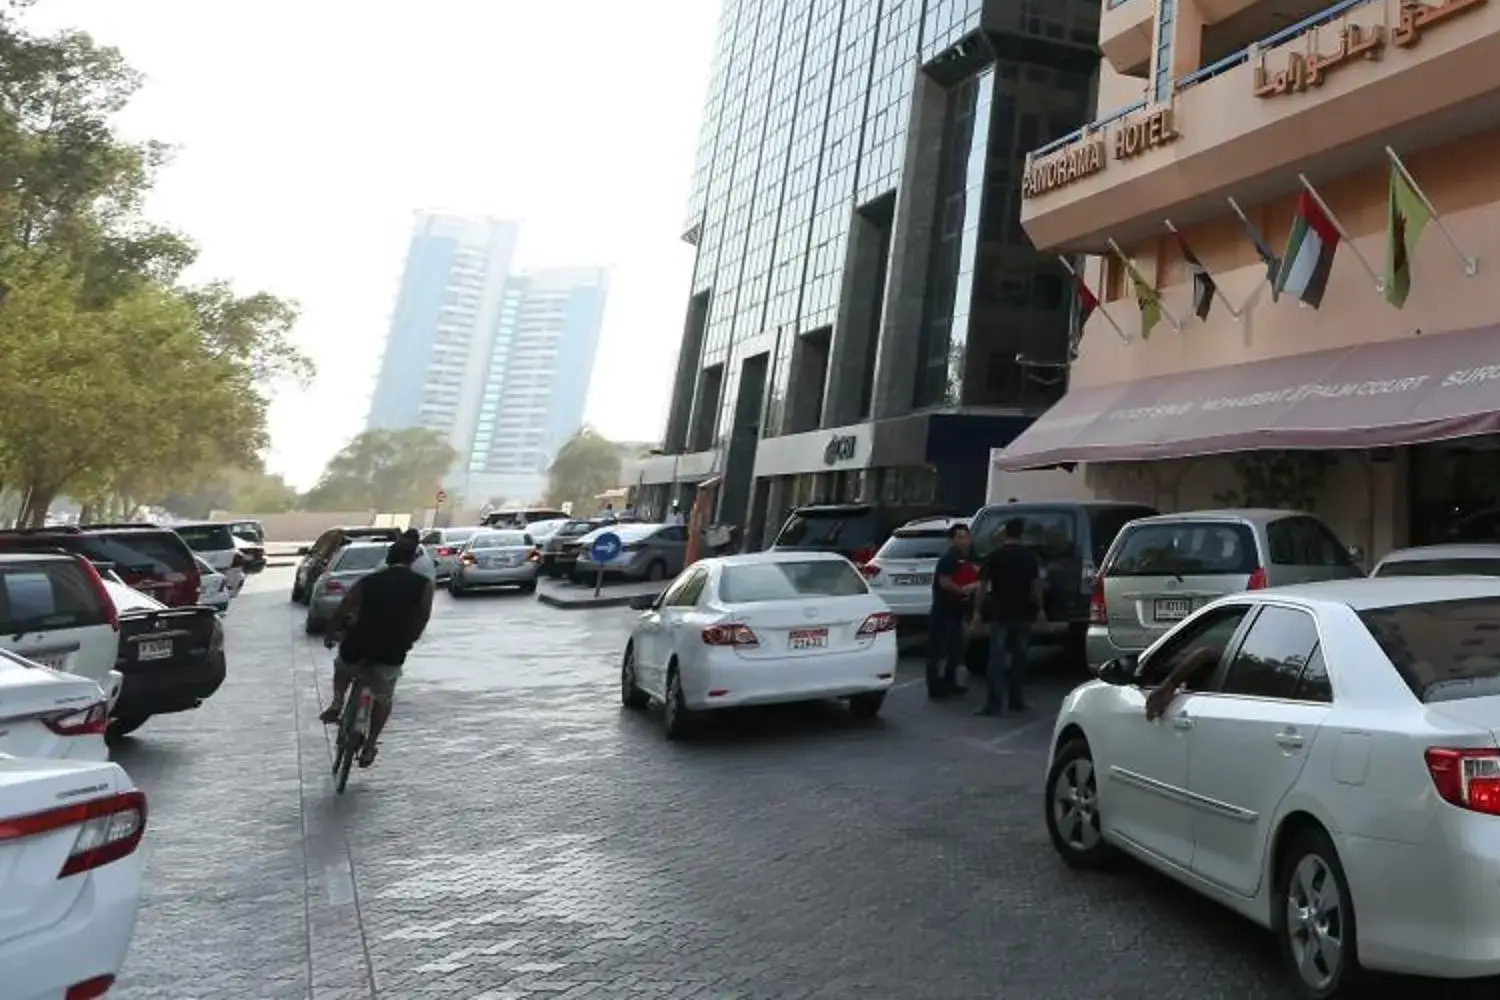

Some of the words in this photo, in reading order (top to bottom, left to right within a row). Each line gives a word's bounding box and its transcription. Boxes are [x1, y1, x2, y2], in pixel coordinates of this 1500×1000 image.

[1022, 138, 1107, 198] PANORAMA
[1115, 108, 1180, 160] HOTEL
[1357, 375, 1431, 396] COURT
